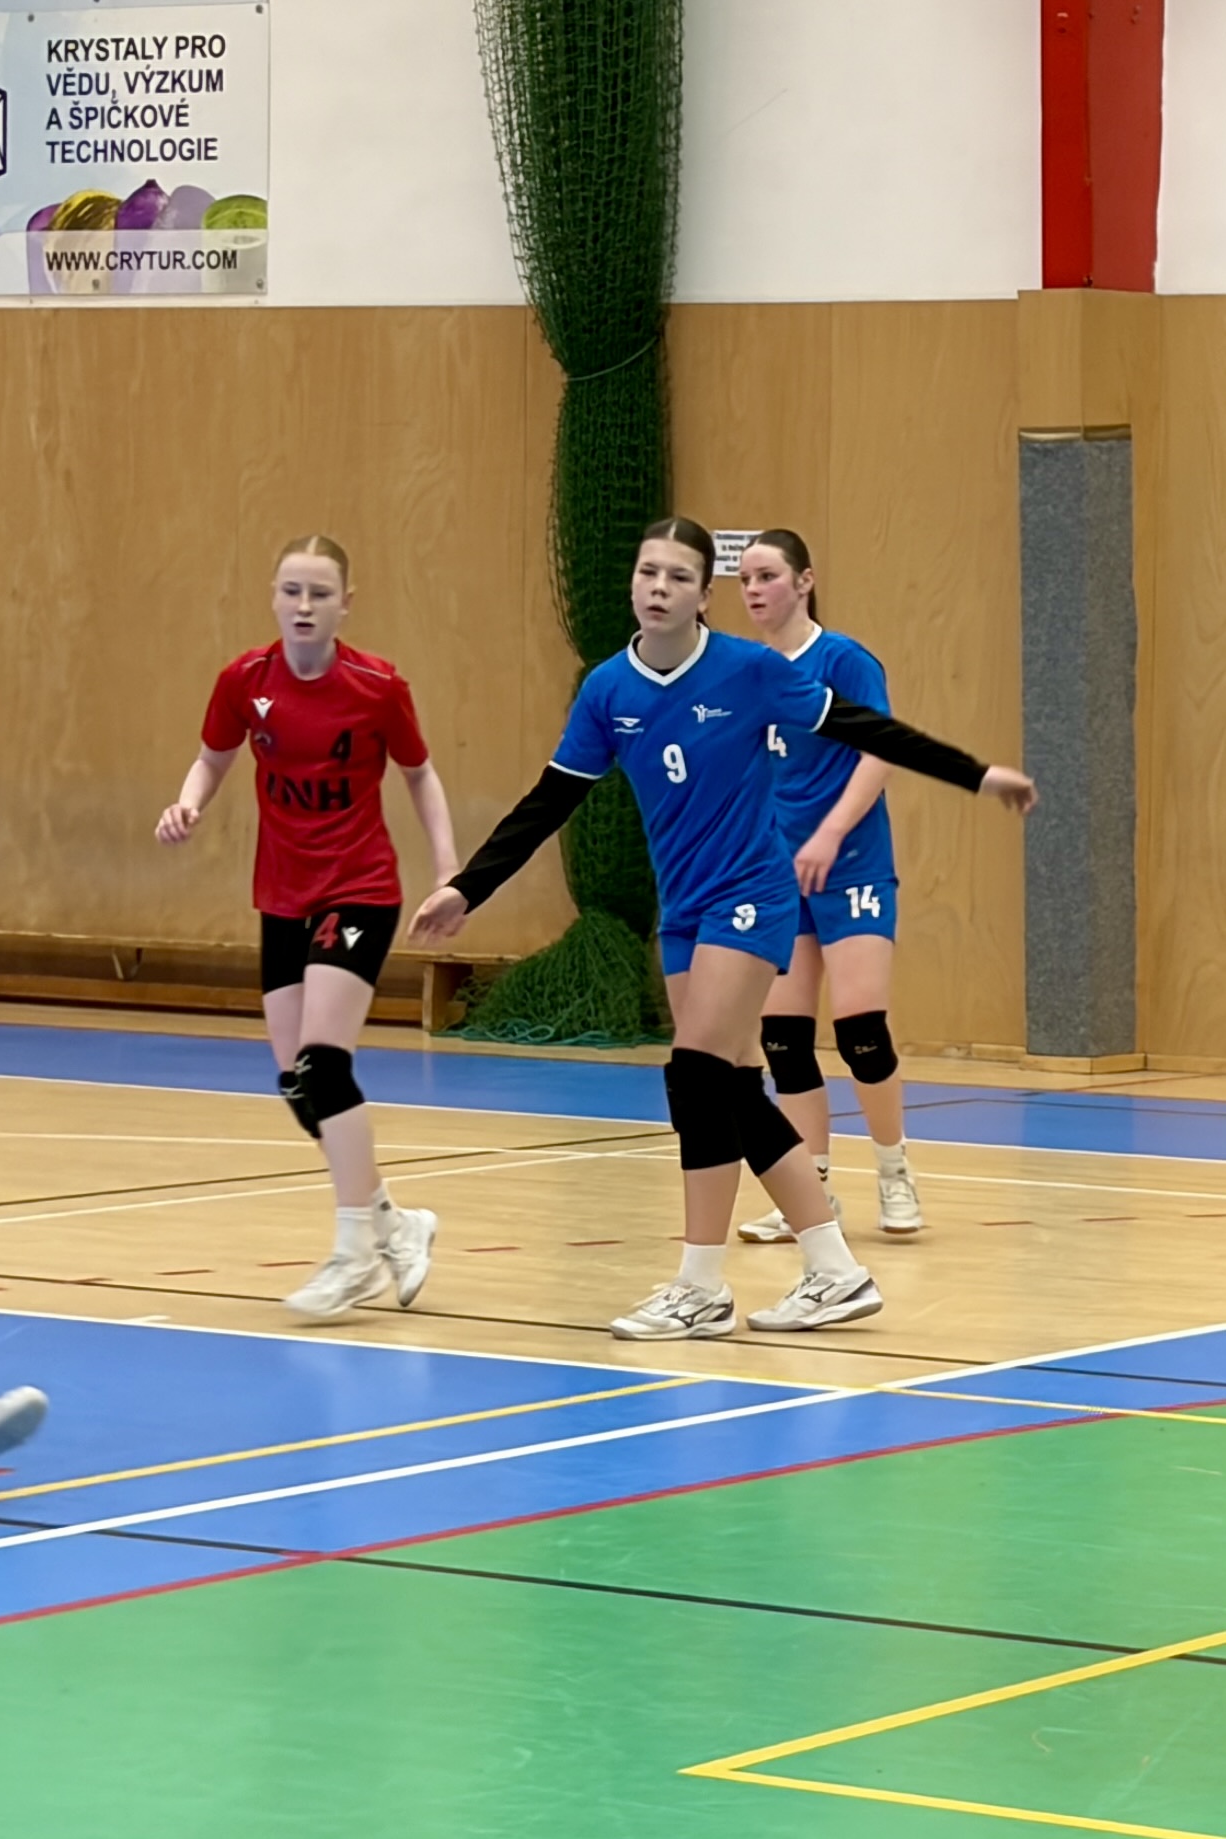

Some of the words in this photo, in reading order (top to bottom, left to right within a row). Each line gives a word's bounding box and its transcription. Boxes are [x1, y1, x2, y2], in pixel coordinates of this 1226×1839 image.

[47, 36, 168, 62] KRYSTALY
[175, 35, 227, 59] PRO
[46, 67, 117, 98] VĚDU,
[124, 63, 224, 94] VÝZKUM
[45, 107, 63, 130] A
[68, 99, 190, 130] ŠPIČKOVÉ
[45, 137, 219, 164] TECHNOLOGIE
[45, 250, 238, 271] WWW.CRYTUR.COM
[330, 730, 352, 767] 4
[663, 743, 687, 783] 9
[845, 885, 881, 918] 14
[314, 912, 340, 950] 4
